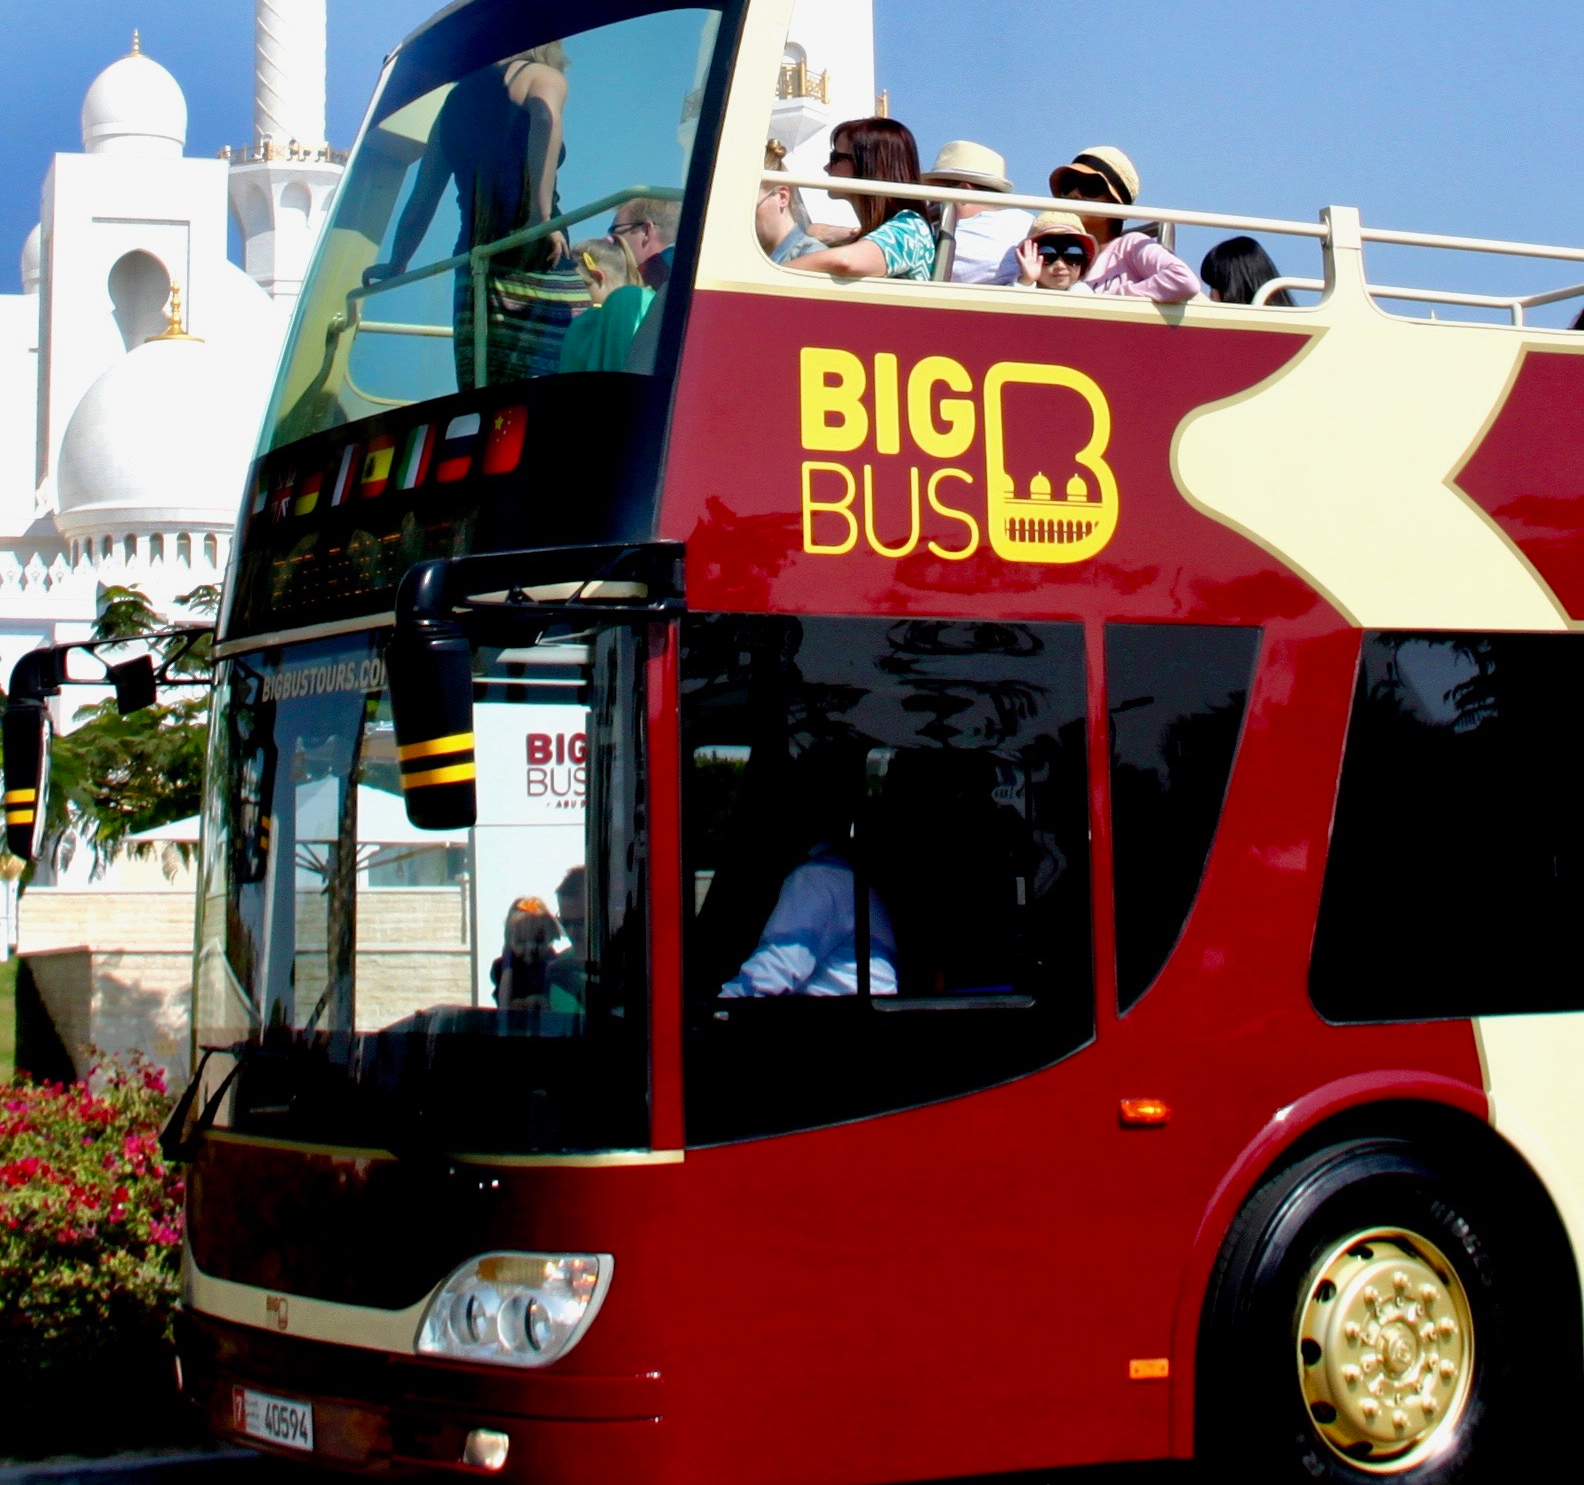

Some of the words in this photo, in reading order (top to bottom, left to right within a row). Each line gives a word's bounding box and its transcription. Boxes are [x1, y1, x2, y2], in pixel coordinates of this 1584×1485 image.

[799, 346, 976, 459] BIG
[801, 460, 980, 561] BUS
[264, 1402, 308, 1444] 40594
